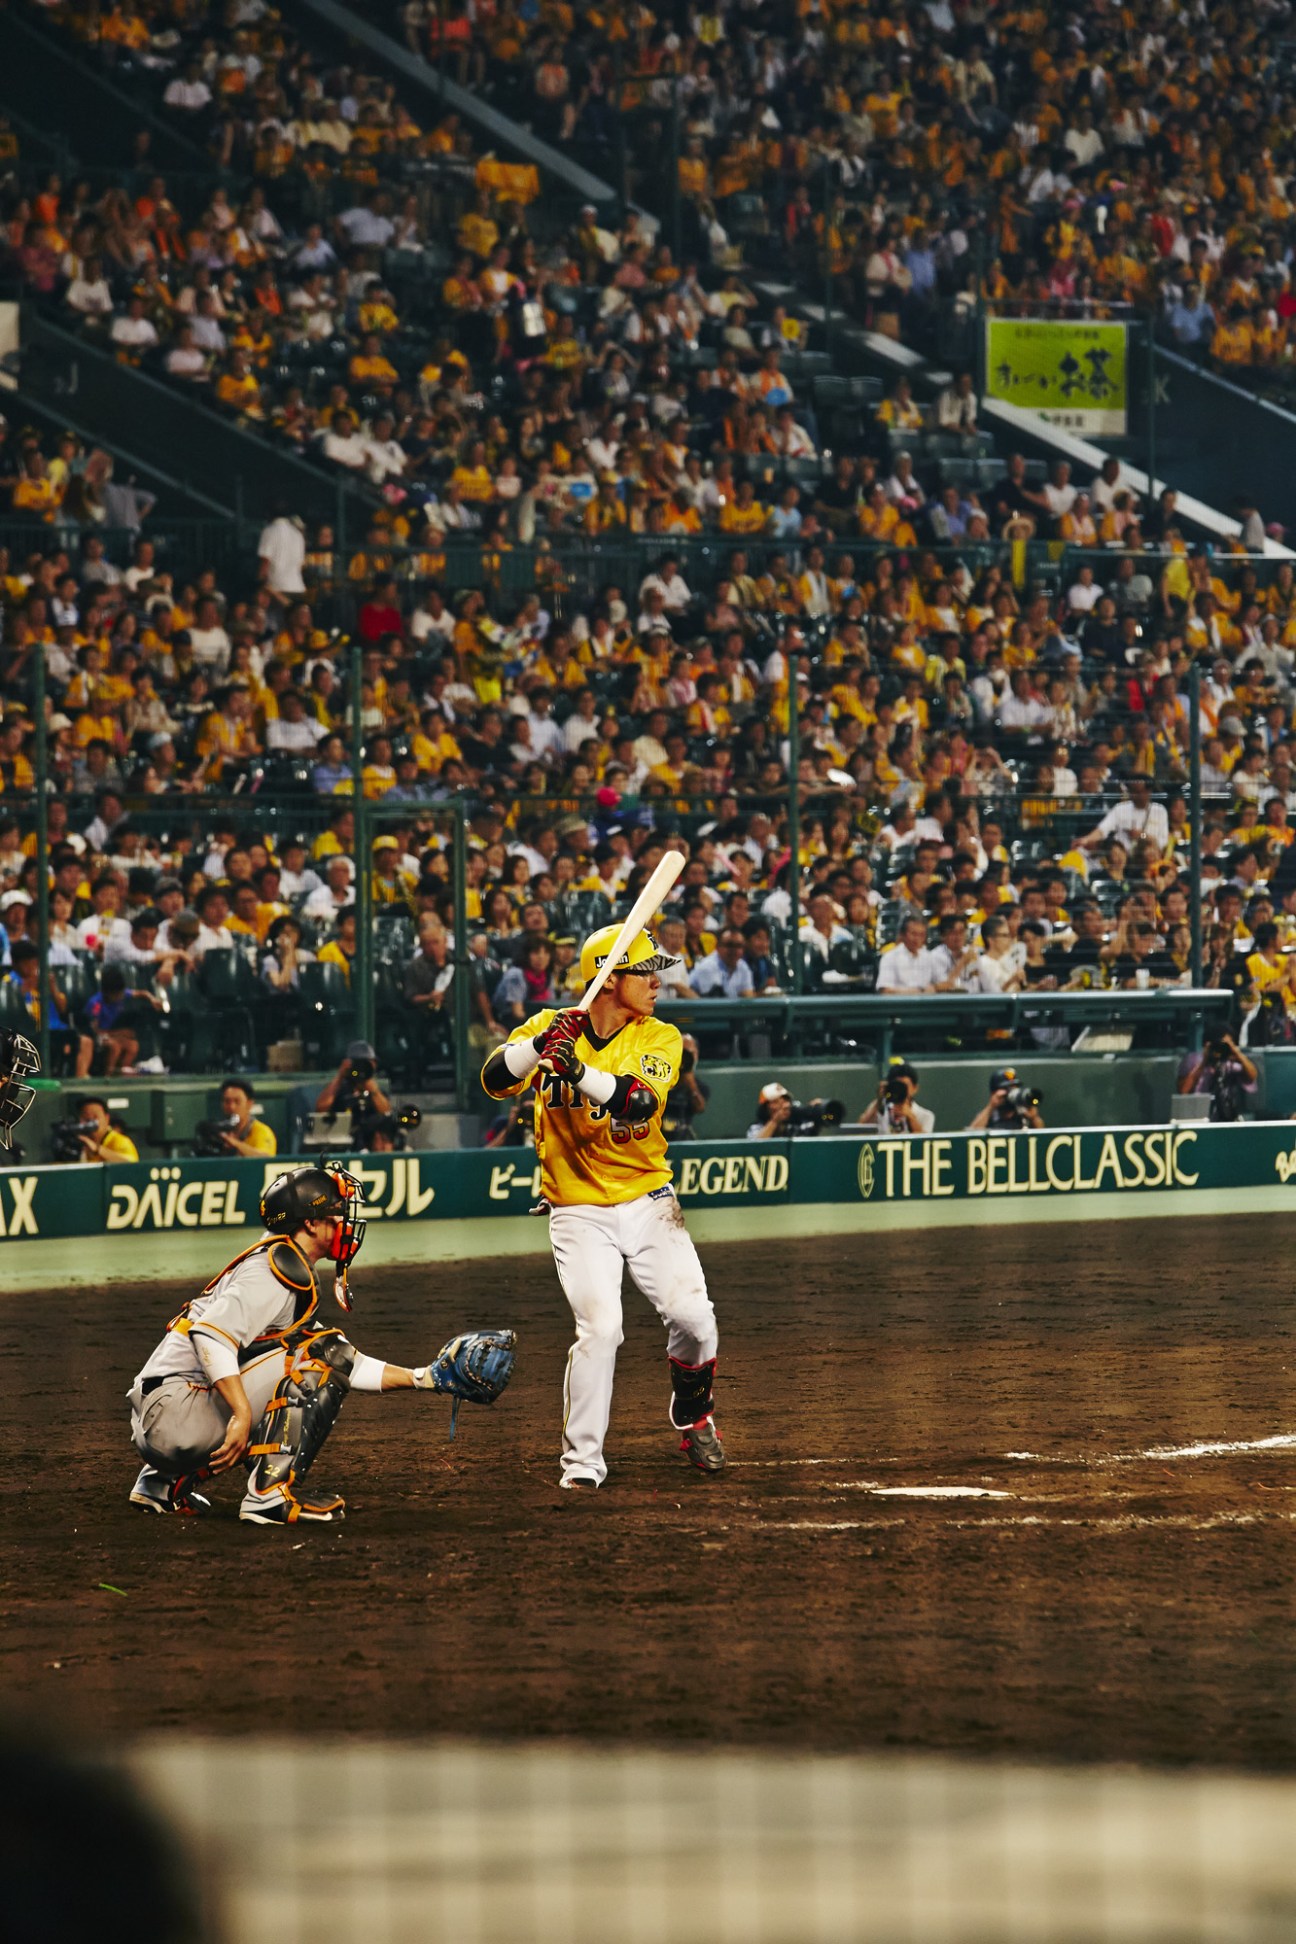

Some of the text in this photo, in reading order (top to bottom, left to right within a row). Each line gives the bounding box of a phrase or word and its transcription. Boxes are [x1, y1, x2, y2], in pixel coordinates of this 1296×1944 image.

[877, 1130, 1199, 1197] THE BELLCLASSIC
[264, 1464, 281, 1478] 22
